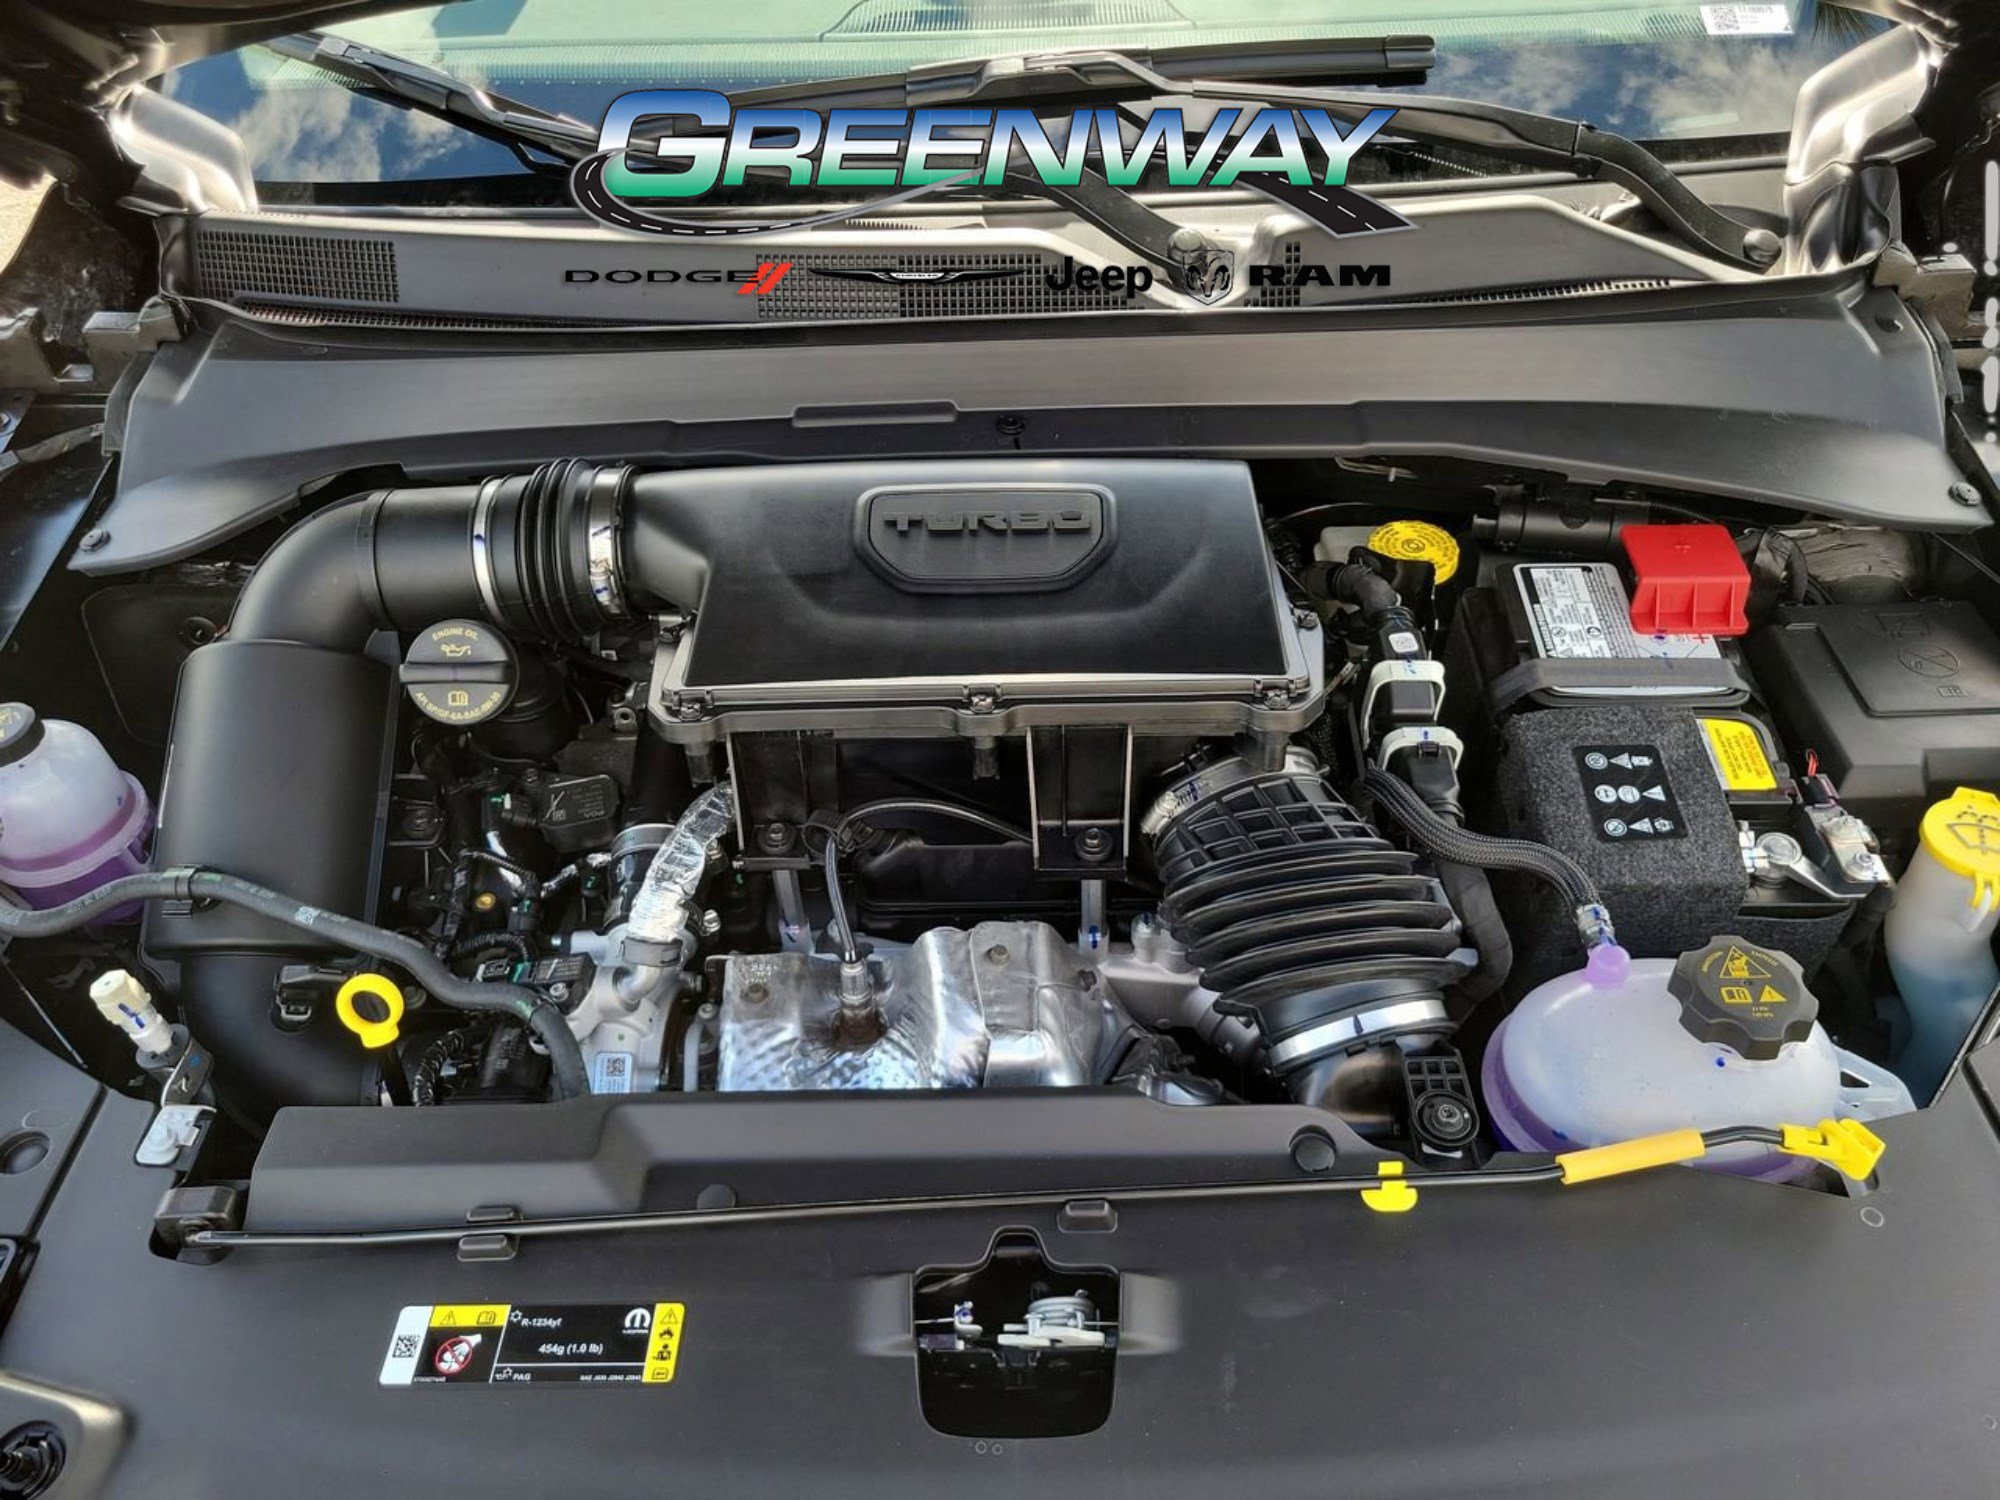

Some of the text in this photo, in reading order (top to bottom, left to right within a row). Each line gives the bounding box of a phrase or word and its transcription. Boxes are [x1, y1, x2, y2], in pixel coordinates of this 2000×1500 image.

[884, 511, 1091, 534] TURBO
[432, 627, 479, 641] ENGINE OIL
[521, 1317, 563, 1328] R-1234yf
[538, 1343, 604, 1356] 454g (1.0 lb)
[512, 1372, 531, 1381] PAG
